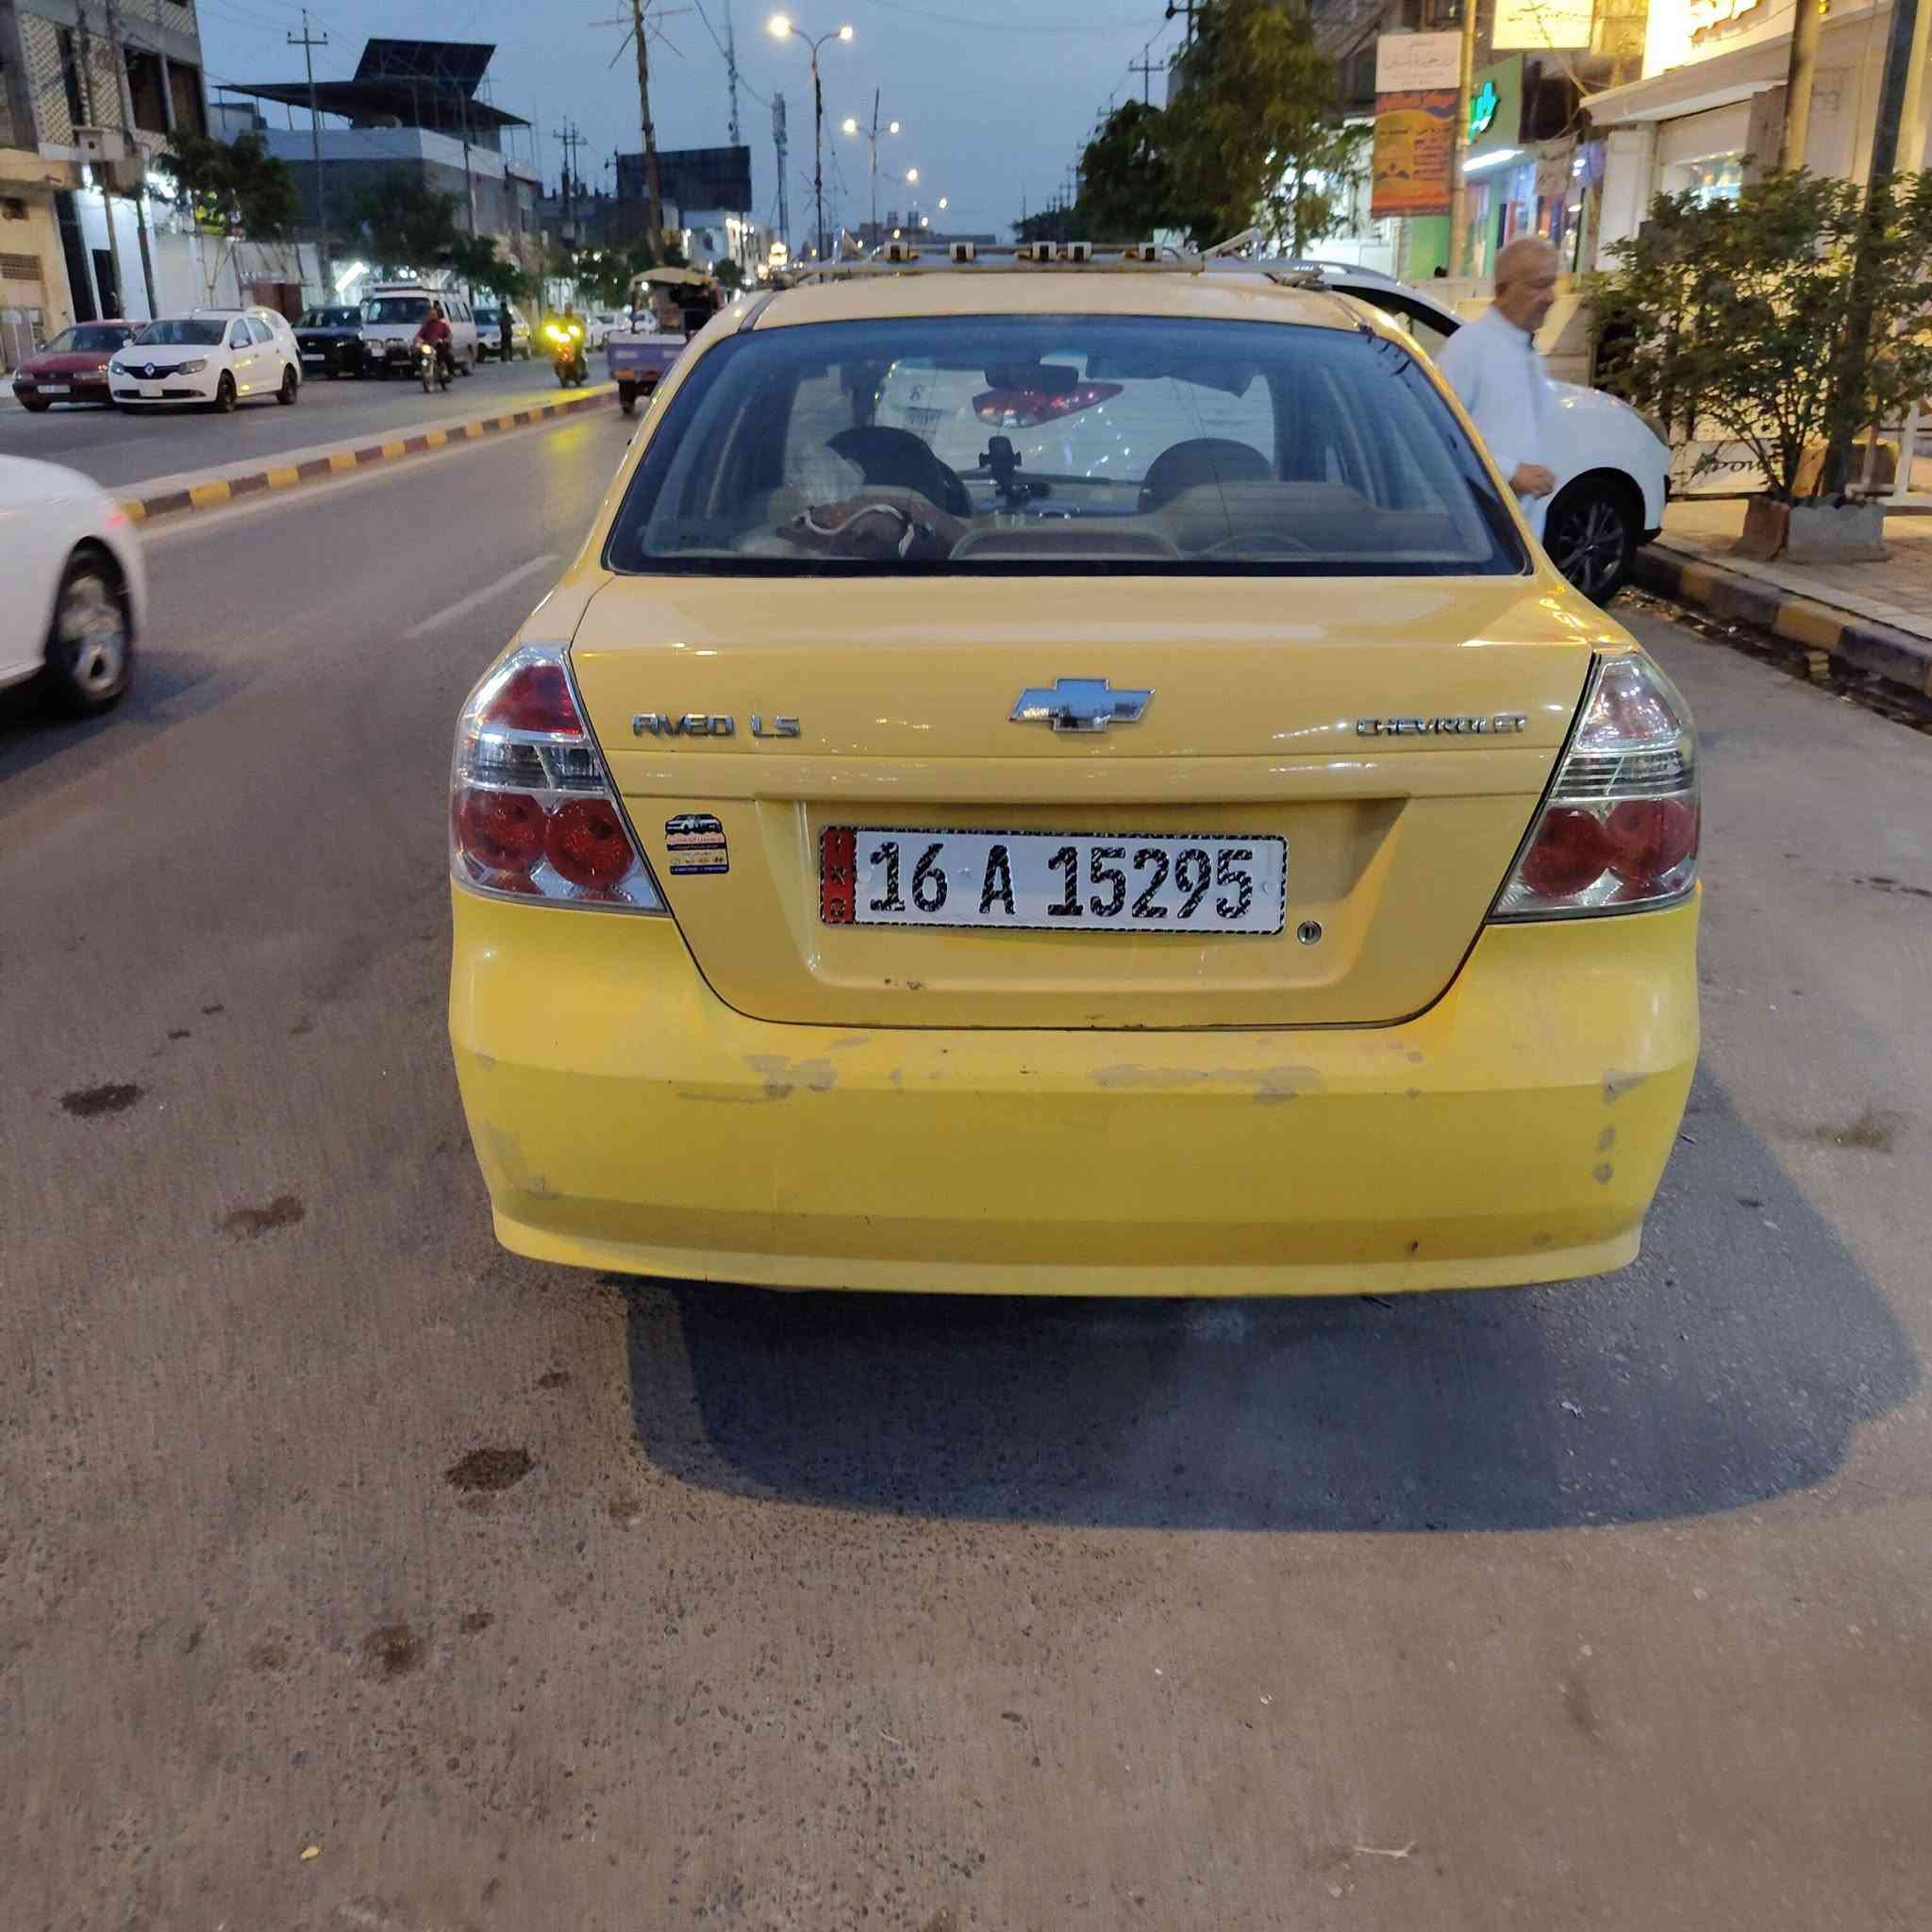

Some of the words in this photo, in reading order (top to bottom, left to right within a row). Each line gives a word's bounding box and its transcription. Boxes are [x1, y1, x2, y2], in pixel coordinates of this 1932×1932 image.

[633, 712, 735, 738] AVEO
[750, 714, 801, 738] LS
[1357, 714, 1527, 737] CHEVROLET
[869, 841, 948, 913] 16
[979, 844, 1016, 915] A
[1047, 846, 1253, 919] 15295
